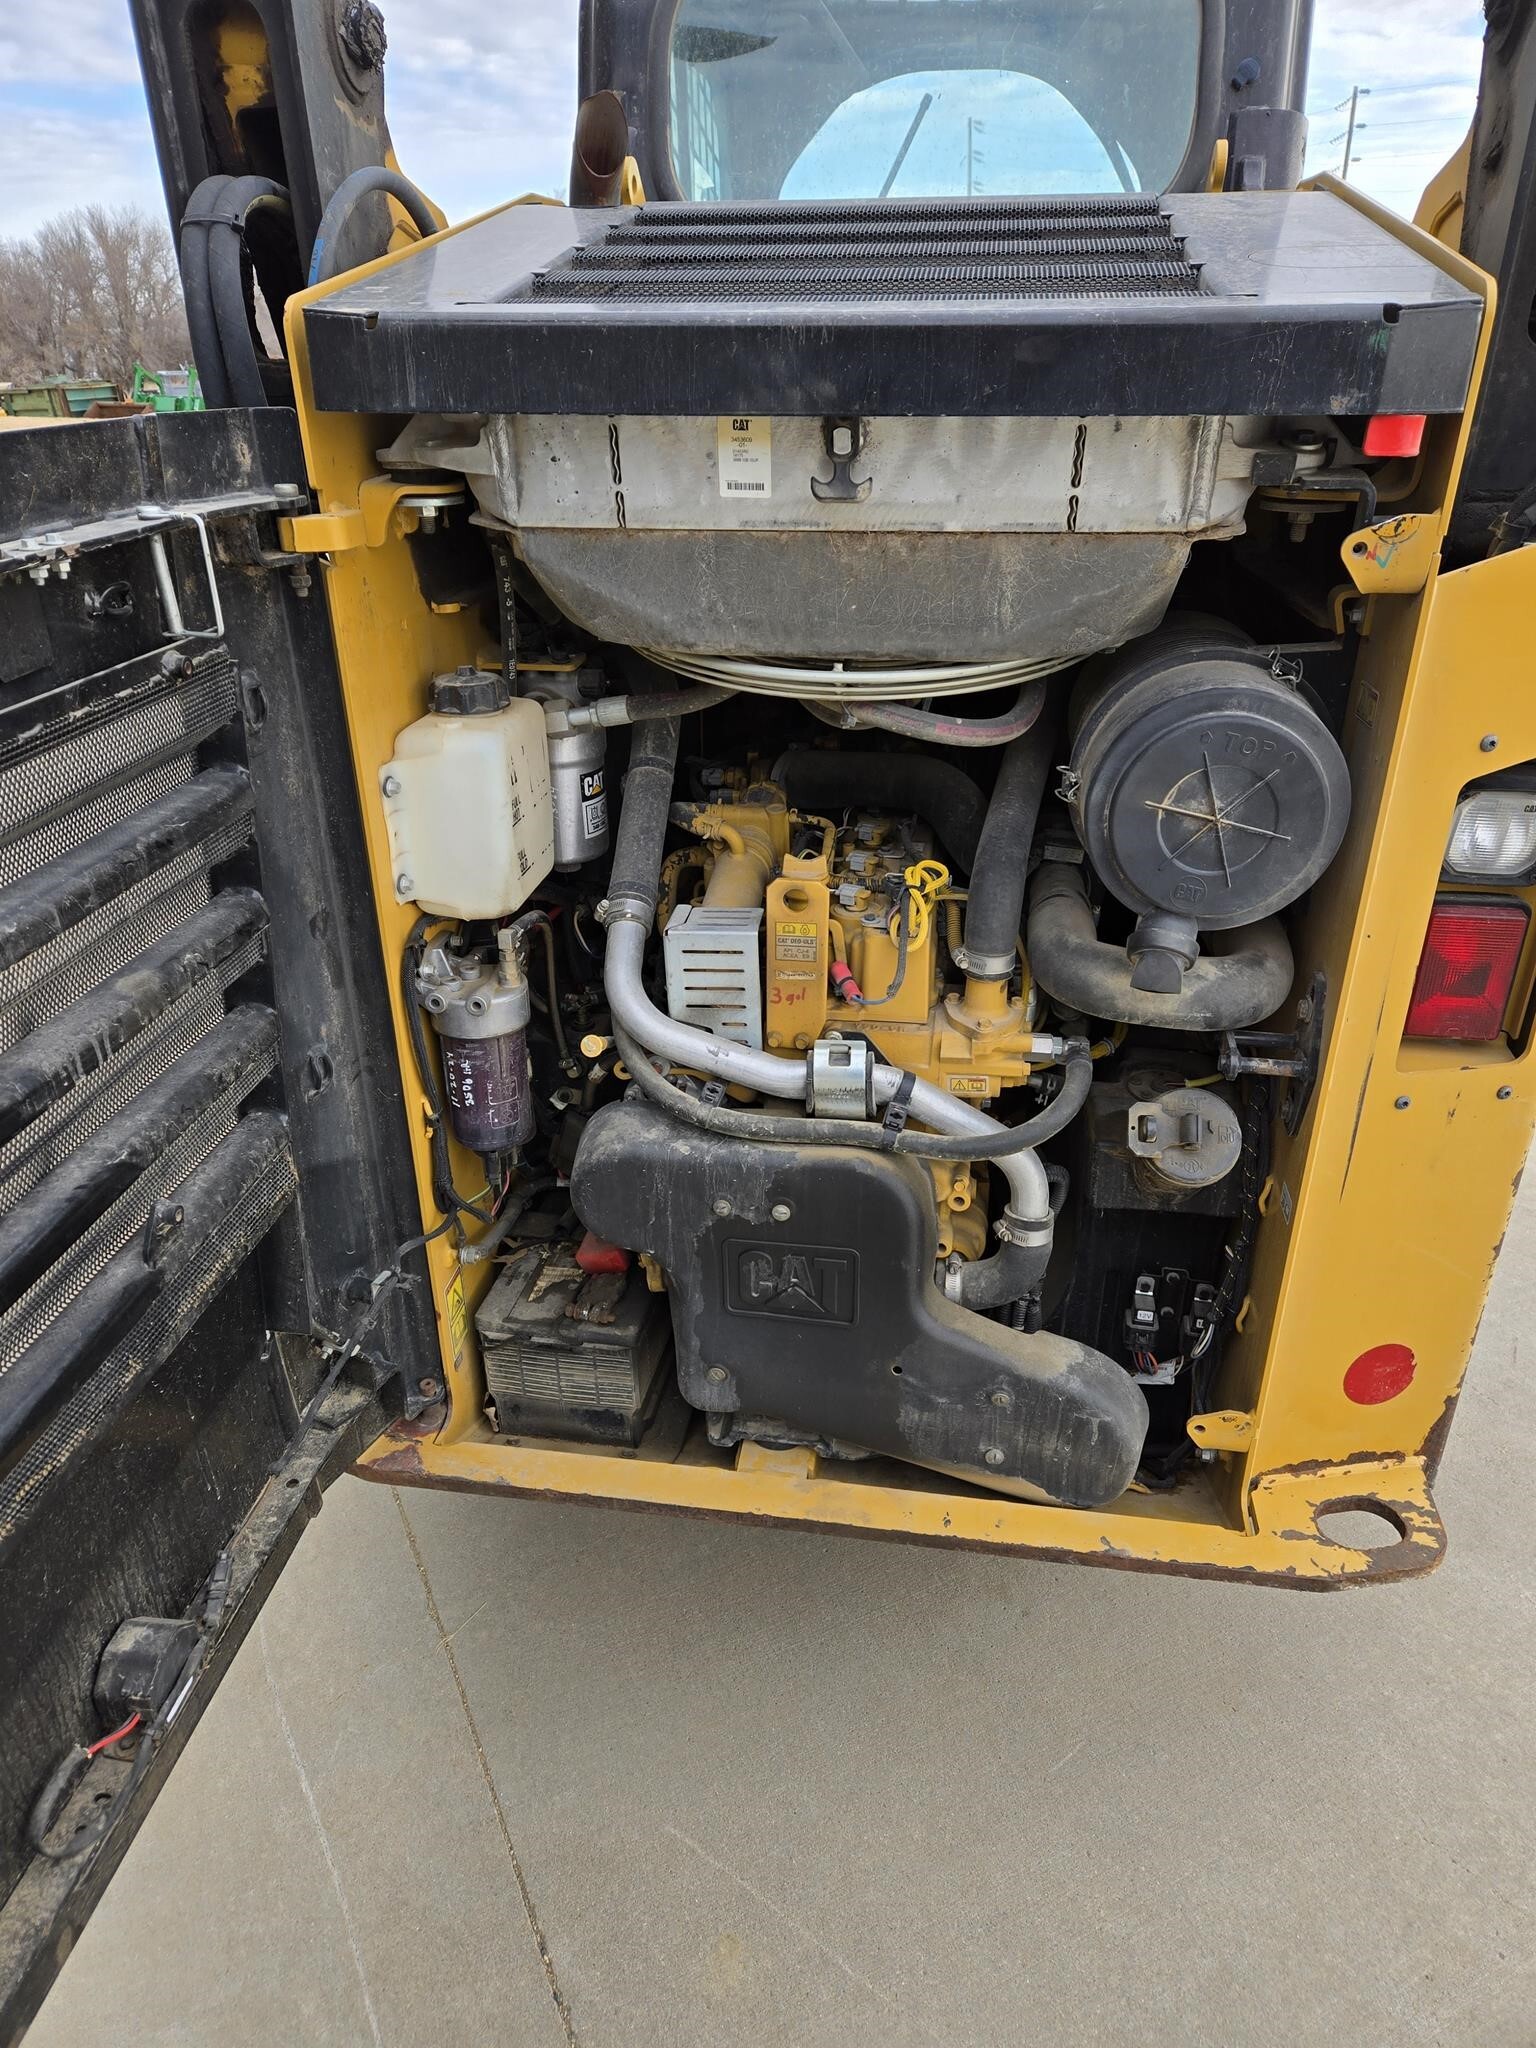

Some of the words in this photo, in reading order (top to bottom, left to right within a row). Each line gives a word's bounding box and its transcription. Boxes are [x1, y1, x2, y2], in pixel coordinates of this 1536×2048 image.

[732, 419, 750, 431] CAT
[1224, 731, 1277, 759] TOP
[583, 771, 604, 797] CAT
[770, 987, 782, 1004] 3
[446, 1052, 461, 1107] 11-20-24
[462, 1078, 475, 1107] 3506
[738, 1250, 847, 1315] CAT
[1138, 1312, 1153, 1320] 12V
